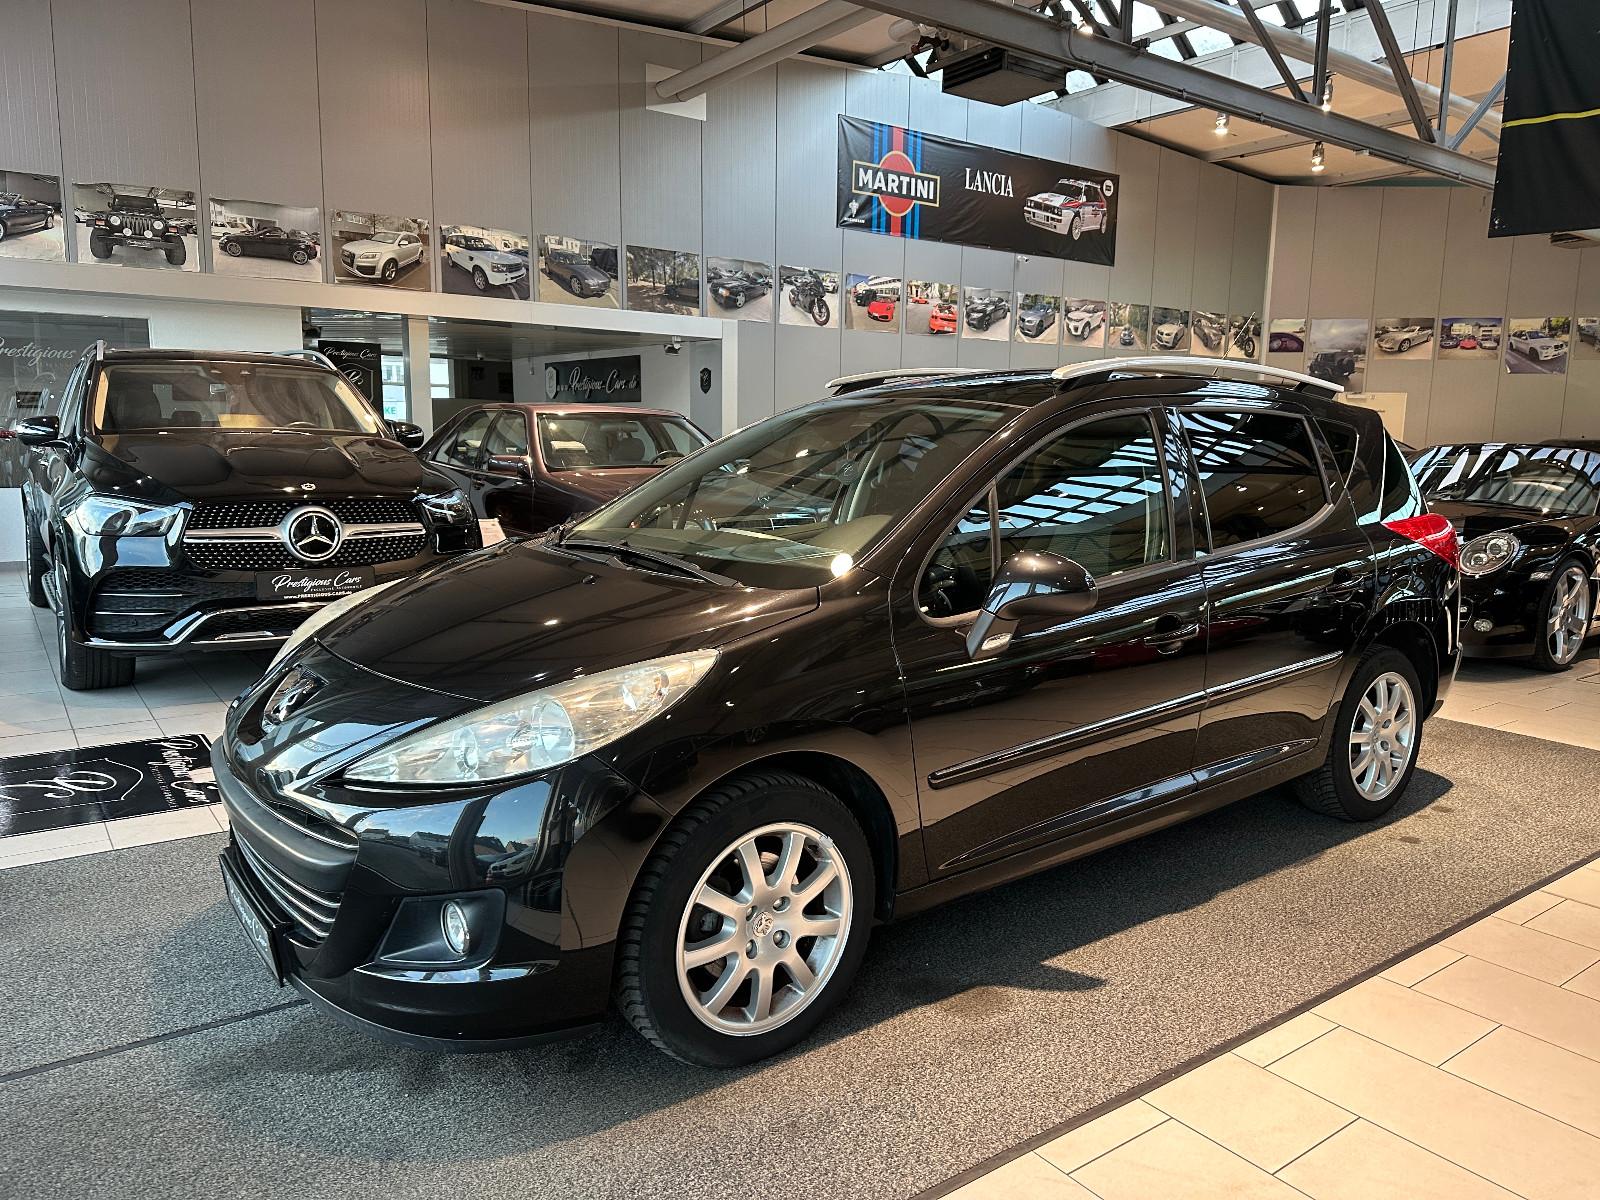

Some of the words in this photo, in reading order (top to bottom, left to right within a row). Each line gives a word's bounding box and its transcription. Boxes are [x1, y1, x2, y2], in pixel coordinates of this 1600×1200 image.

[858, 167, 935, 200] MARTINI
[964, 167, 1014, 198] LANCIA
[0, 336, 76, 367] restigious
[271, 574, 332, 592] Prestigious
[333, 570, 362, 587] Cars
